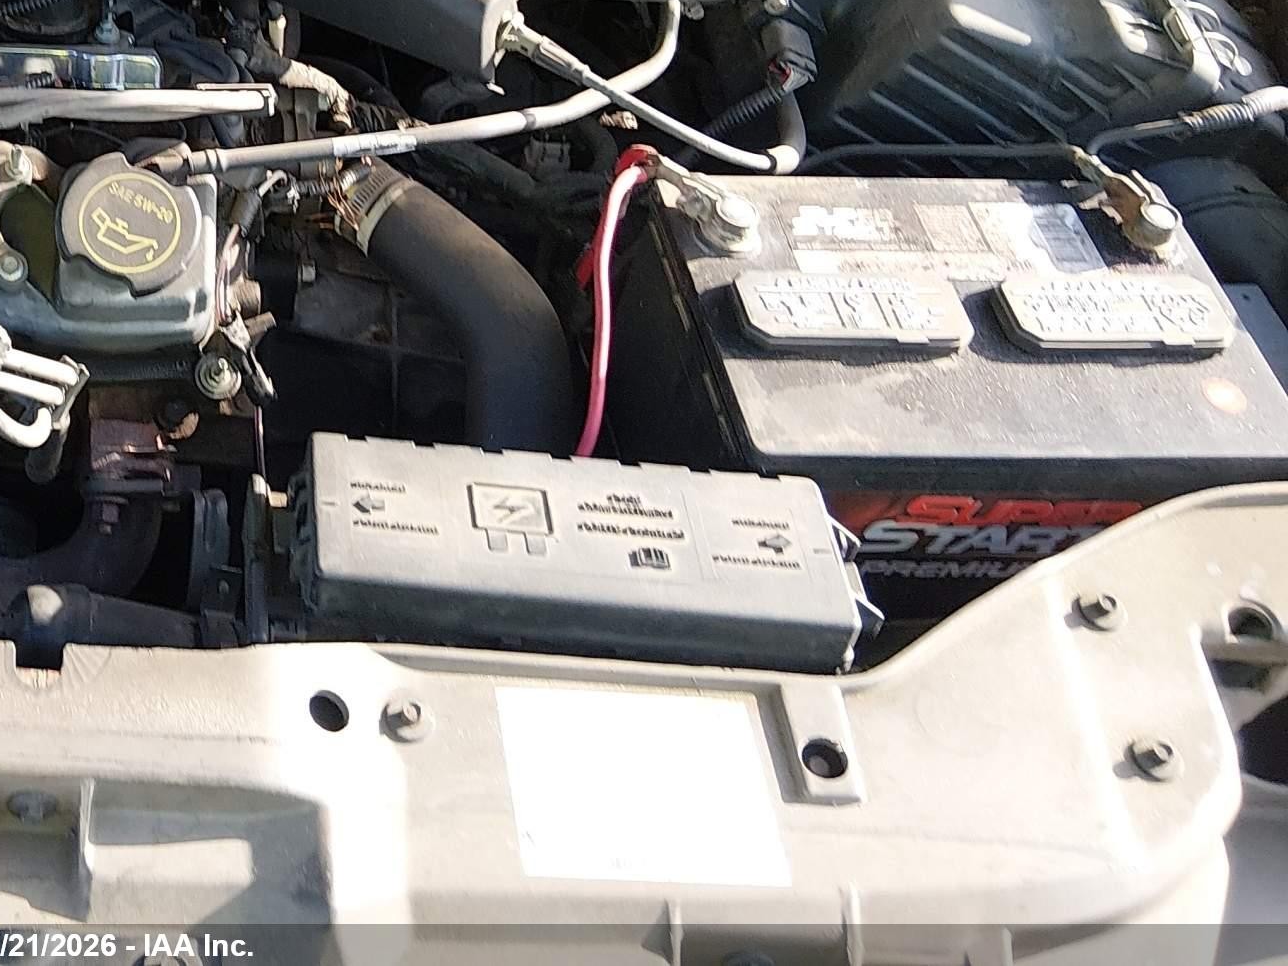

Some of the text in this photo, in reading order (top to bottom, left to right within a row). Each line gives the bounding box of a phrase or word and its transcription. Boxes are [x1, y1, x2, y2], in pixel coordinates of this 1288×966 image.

[108, 180, 174, 224] SAE 5W-20
[896, 494, 1143, 525] SUPER
[862, 559, 1029, 579] PREMIU
